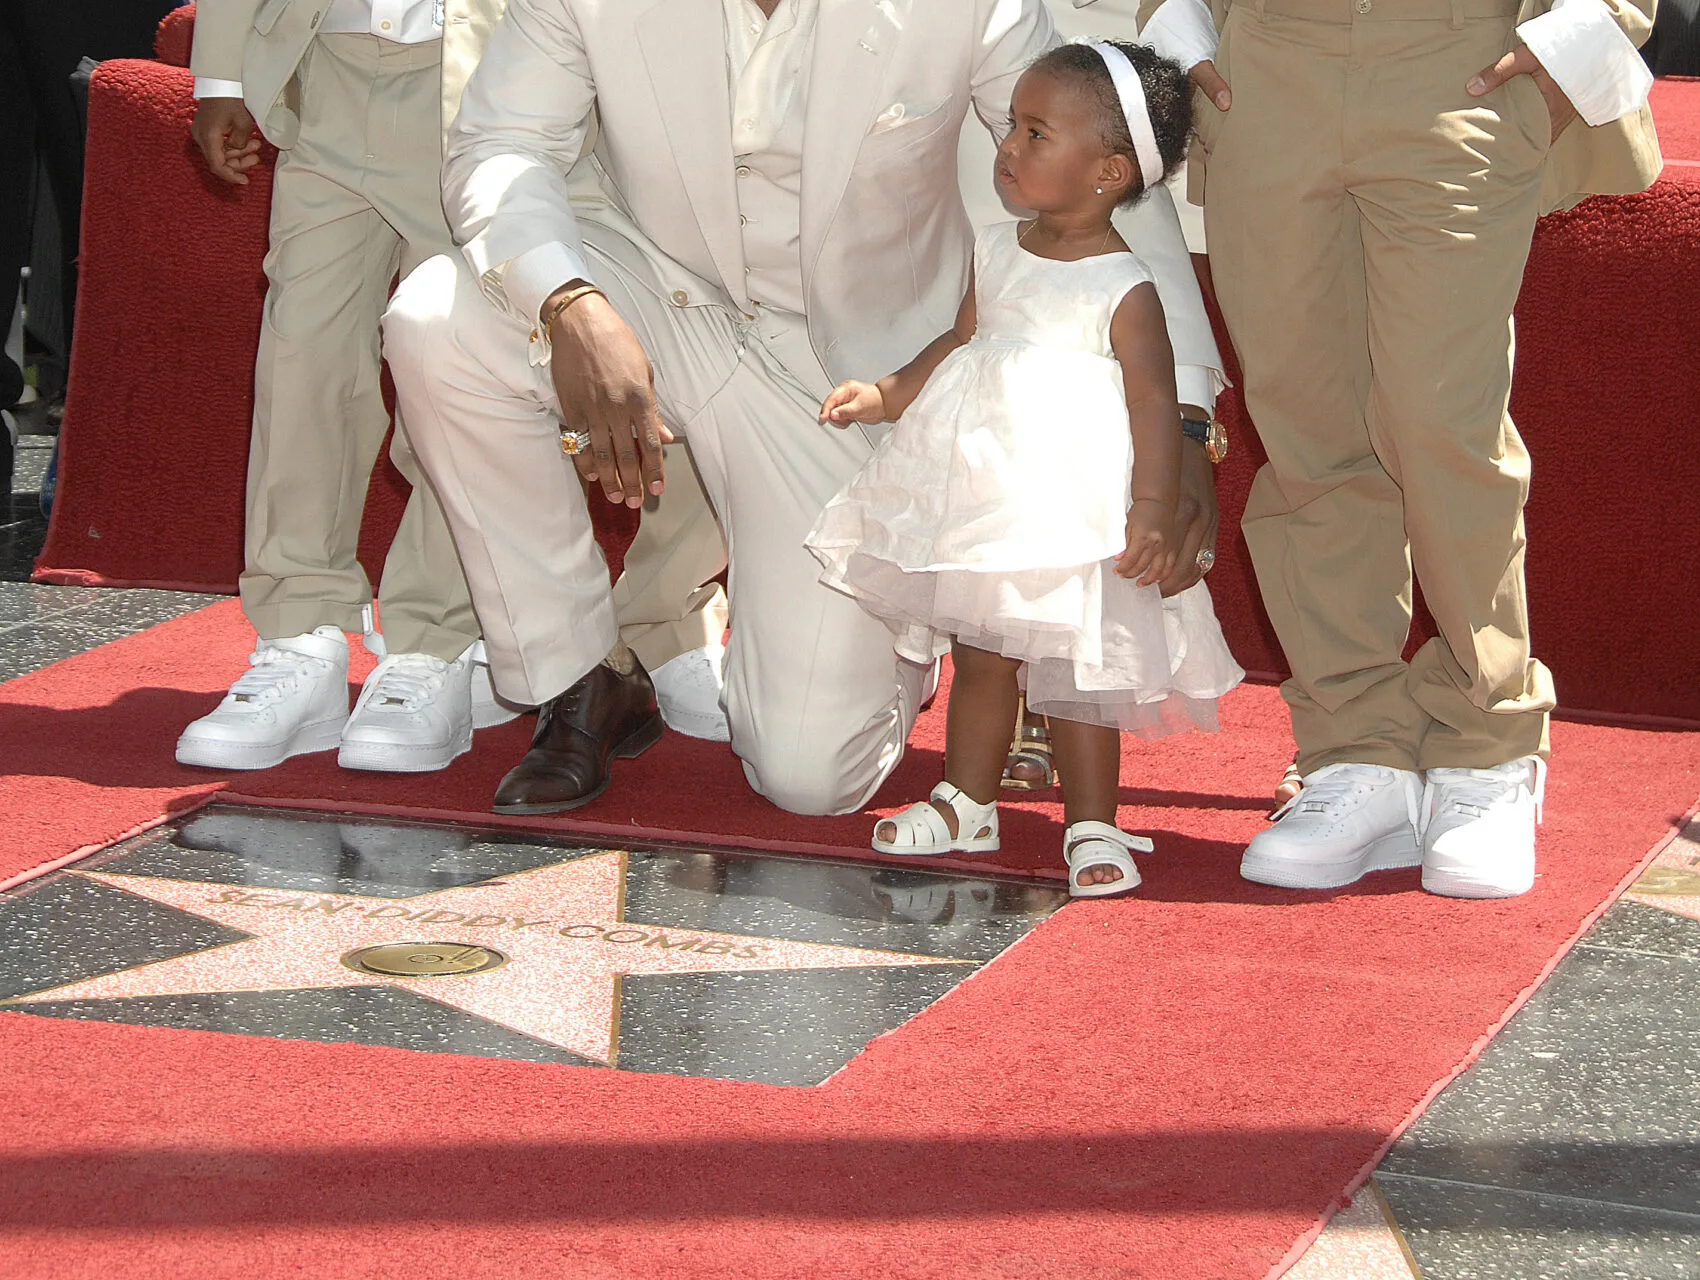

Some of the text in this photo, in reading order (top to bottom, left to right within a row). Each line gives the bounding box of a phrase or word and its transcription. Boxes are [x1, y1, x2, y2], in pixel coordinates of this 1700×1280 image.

[207, 890, 770, 959] SEAN DIDDY COMBS
